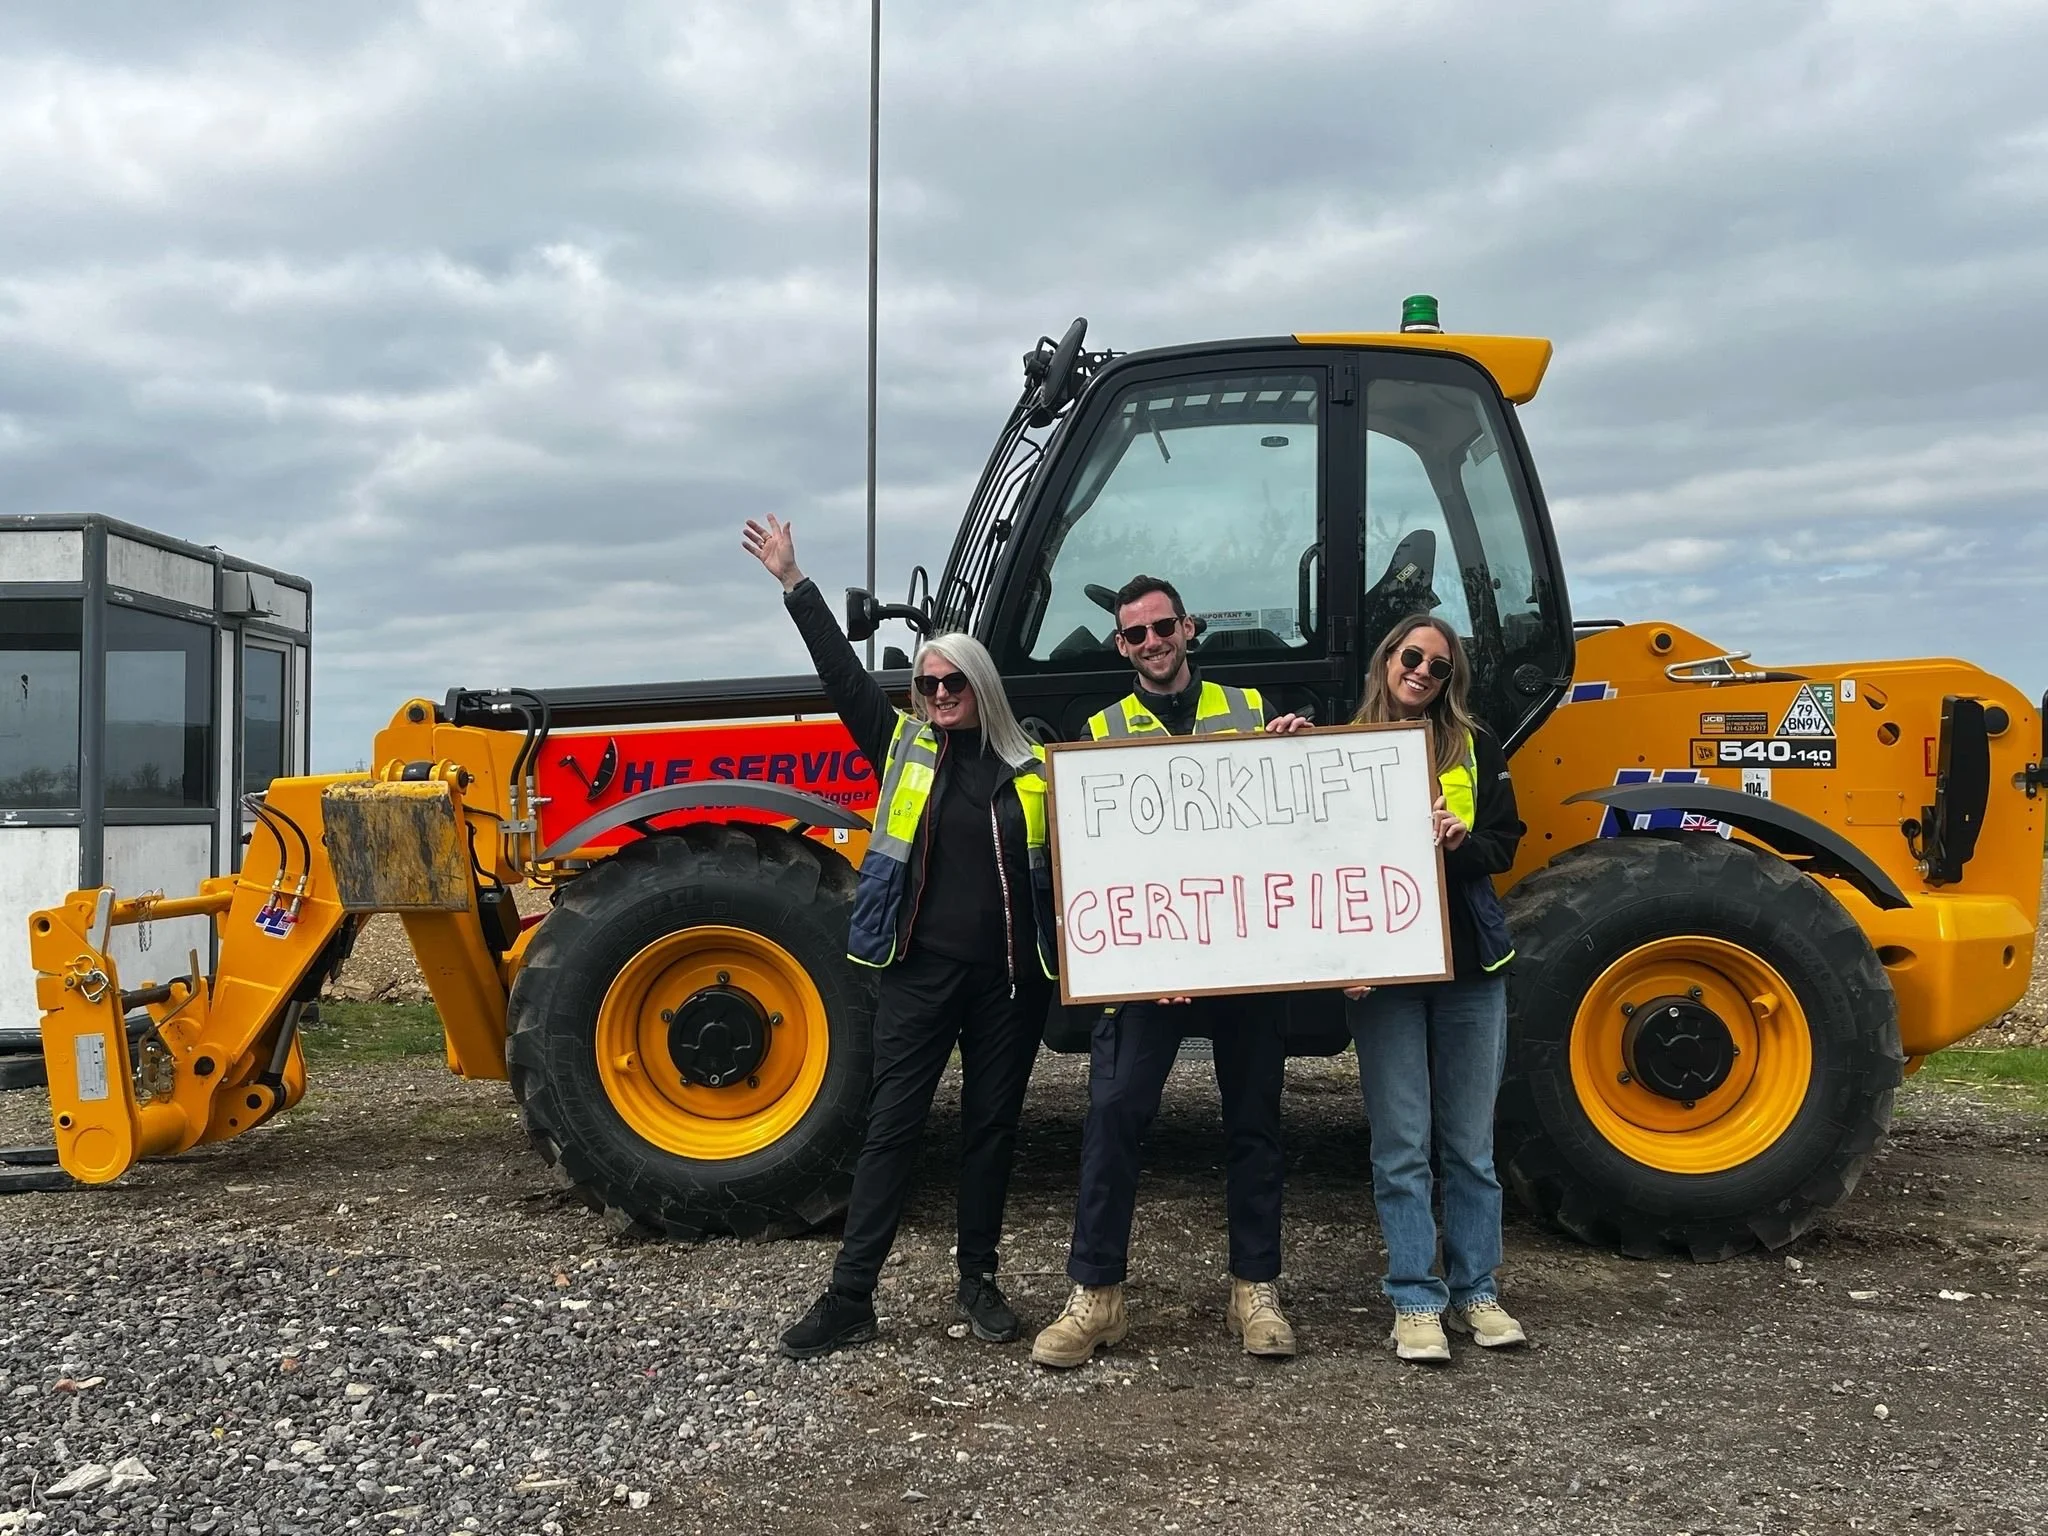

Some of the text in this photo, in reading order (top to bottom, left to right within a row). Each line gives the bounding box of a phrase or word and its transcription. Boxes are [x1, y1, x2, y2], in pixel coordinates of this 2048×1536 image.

[1797, 704, 1813, 717] 79
[1788, 718, 1822, 730] BN9V
[1720, 741, 1832, 761] 540-140
[1081, 746, 1400, 838] FORKLIFT
[1744, 782, 1761, 796] 104
[1066, 865, 1422, 954] CERTIFIED
